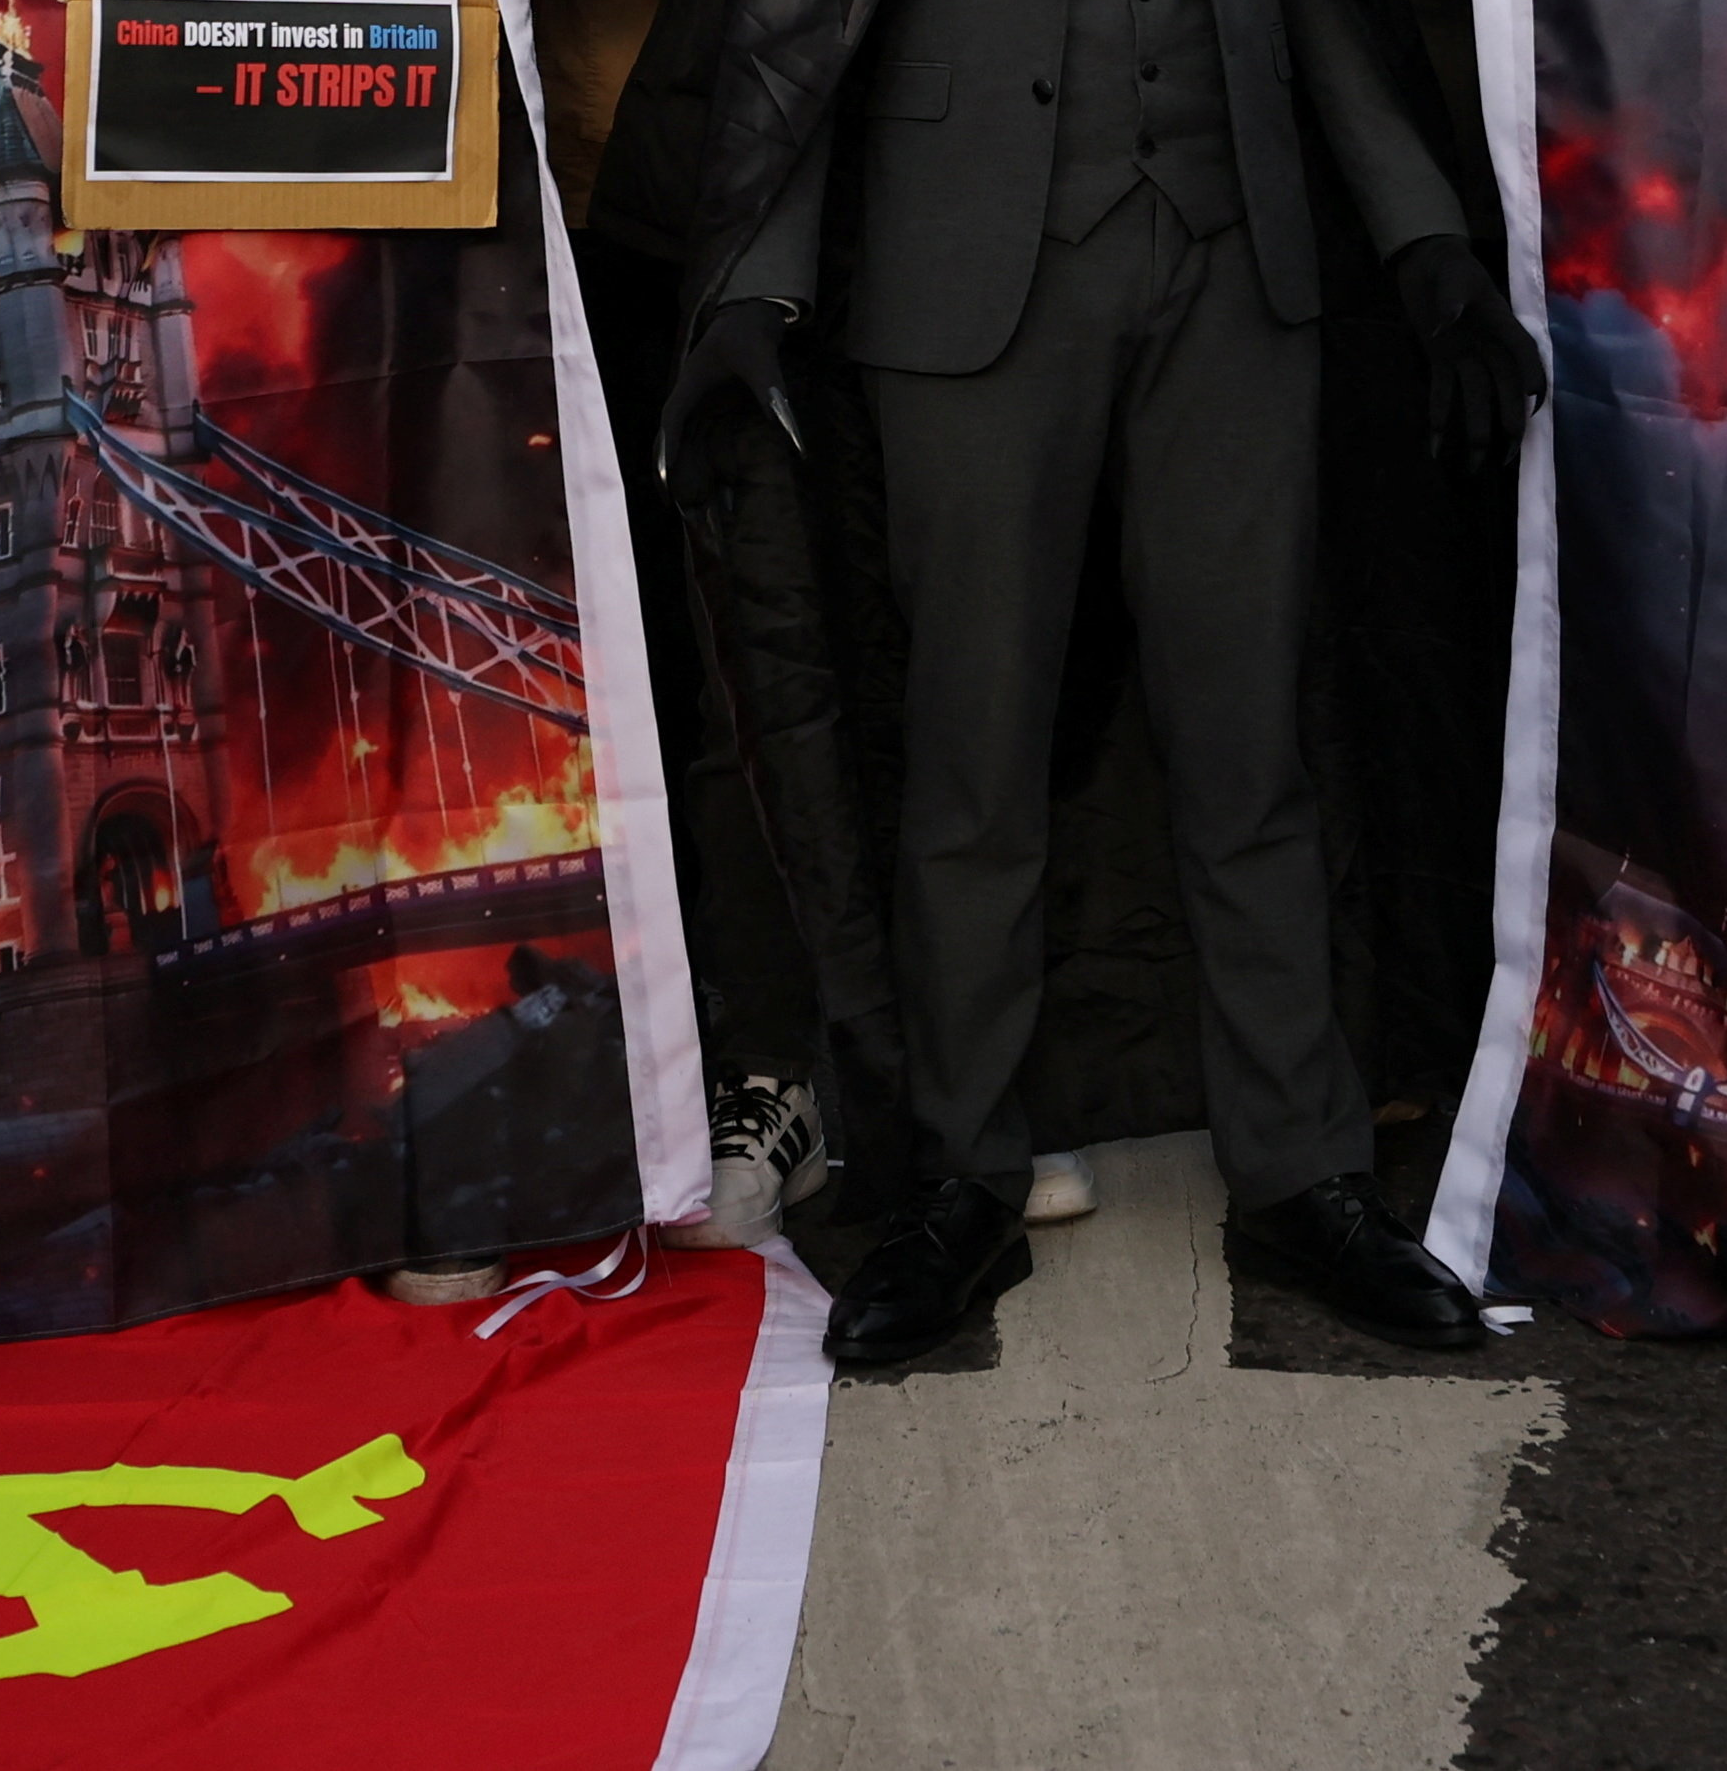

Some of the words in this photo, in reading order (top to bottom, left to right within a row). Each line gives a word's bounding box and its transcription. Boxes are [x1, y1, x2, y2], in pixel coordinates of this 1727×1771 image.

[117, 19, 179, 46] China
[271, 22, 337, 49] invest
[343, 23, 363, 49] in
[369, 25, 437, 50] Britain
[234, 62, 267, 106] IT
[276, 63, 396, 108] STRIPS
[406, 65, 437, 108] IT
